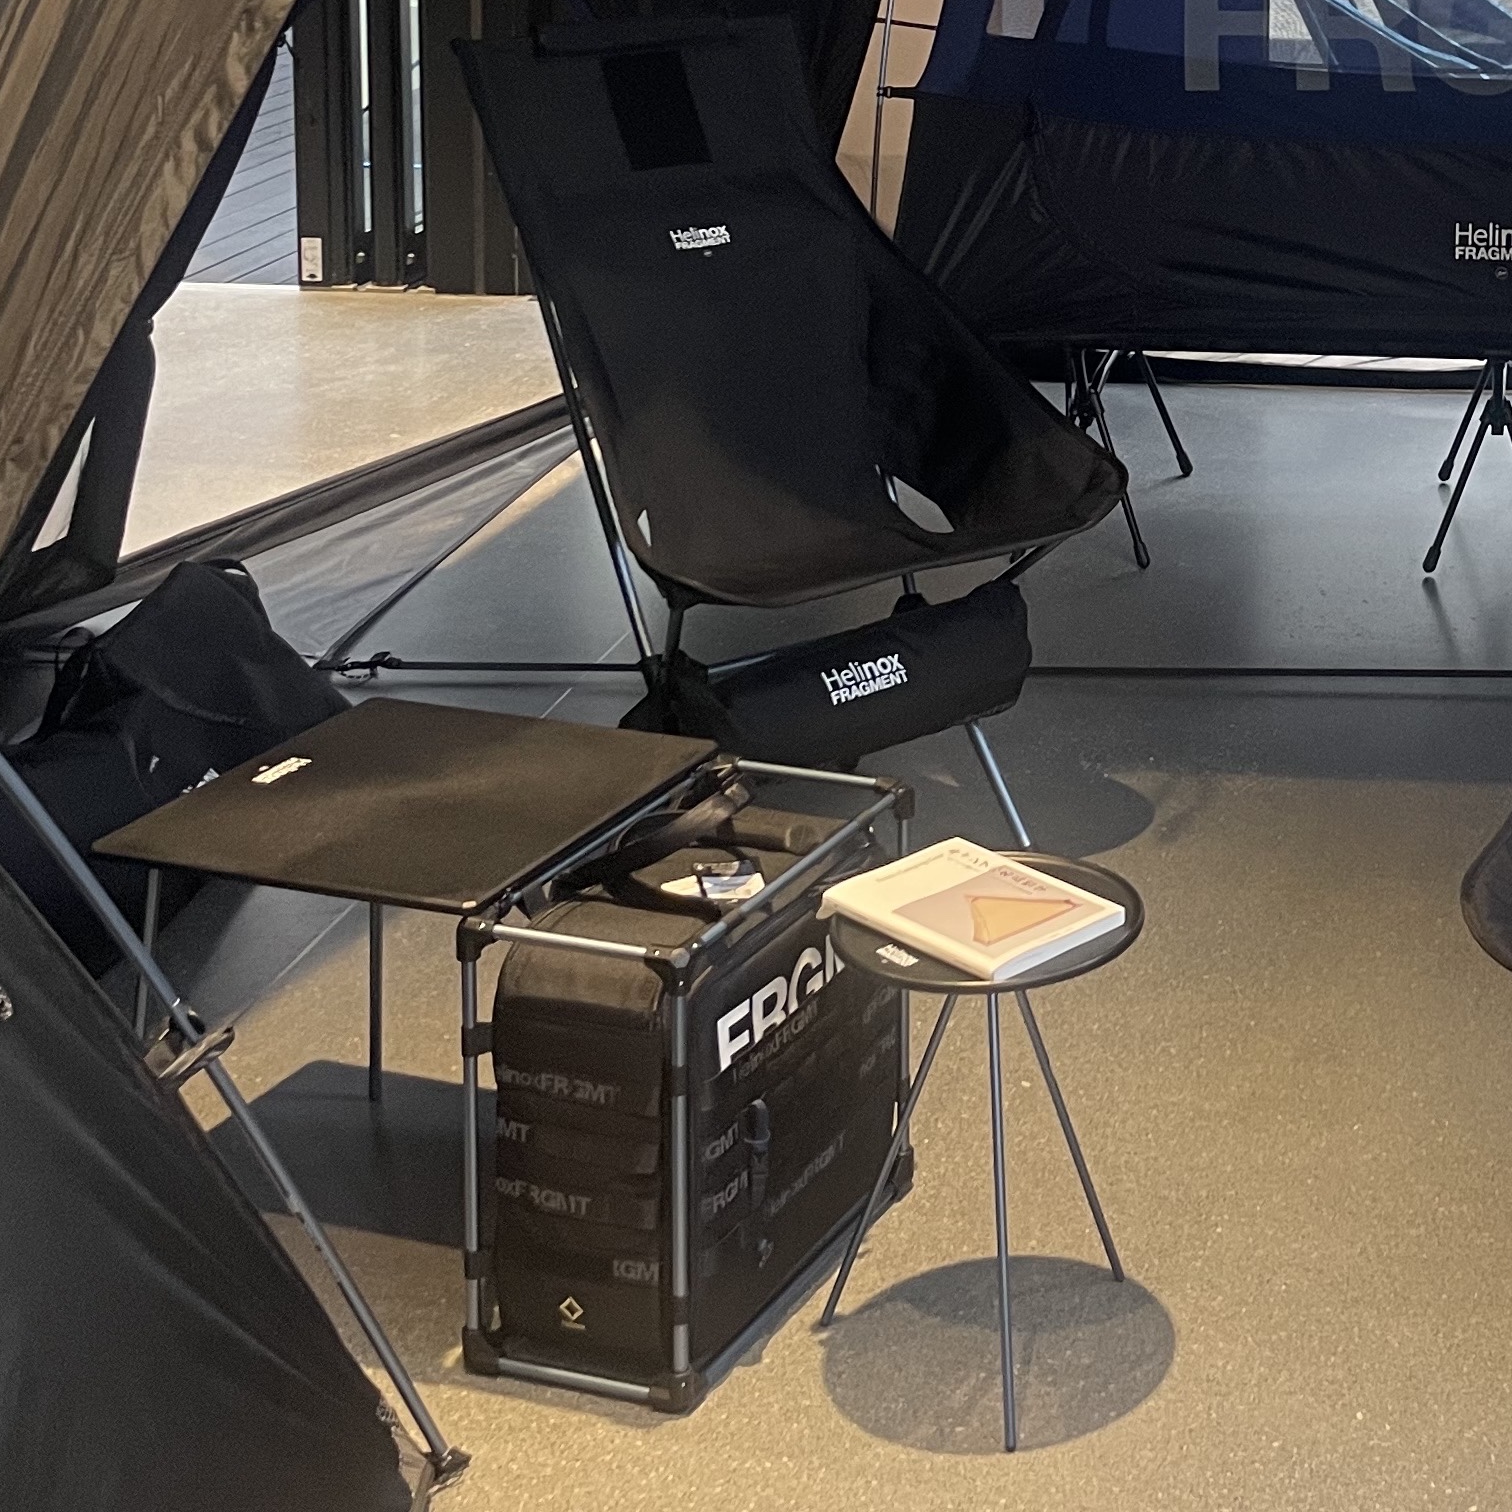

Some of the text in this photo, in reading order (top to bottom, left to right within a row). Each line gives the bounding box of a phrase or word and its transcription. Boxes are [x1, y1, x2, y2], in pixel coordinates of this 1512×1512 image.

[669, 225, 729, 243] Helinox
[820, 653, 905, 692] Helinox
[830, 669, 908, 706] FRAGMENT
